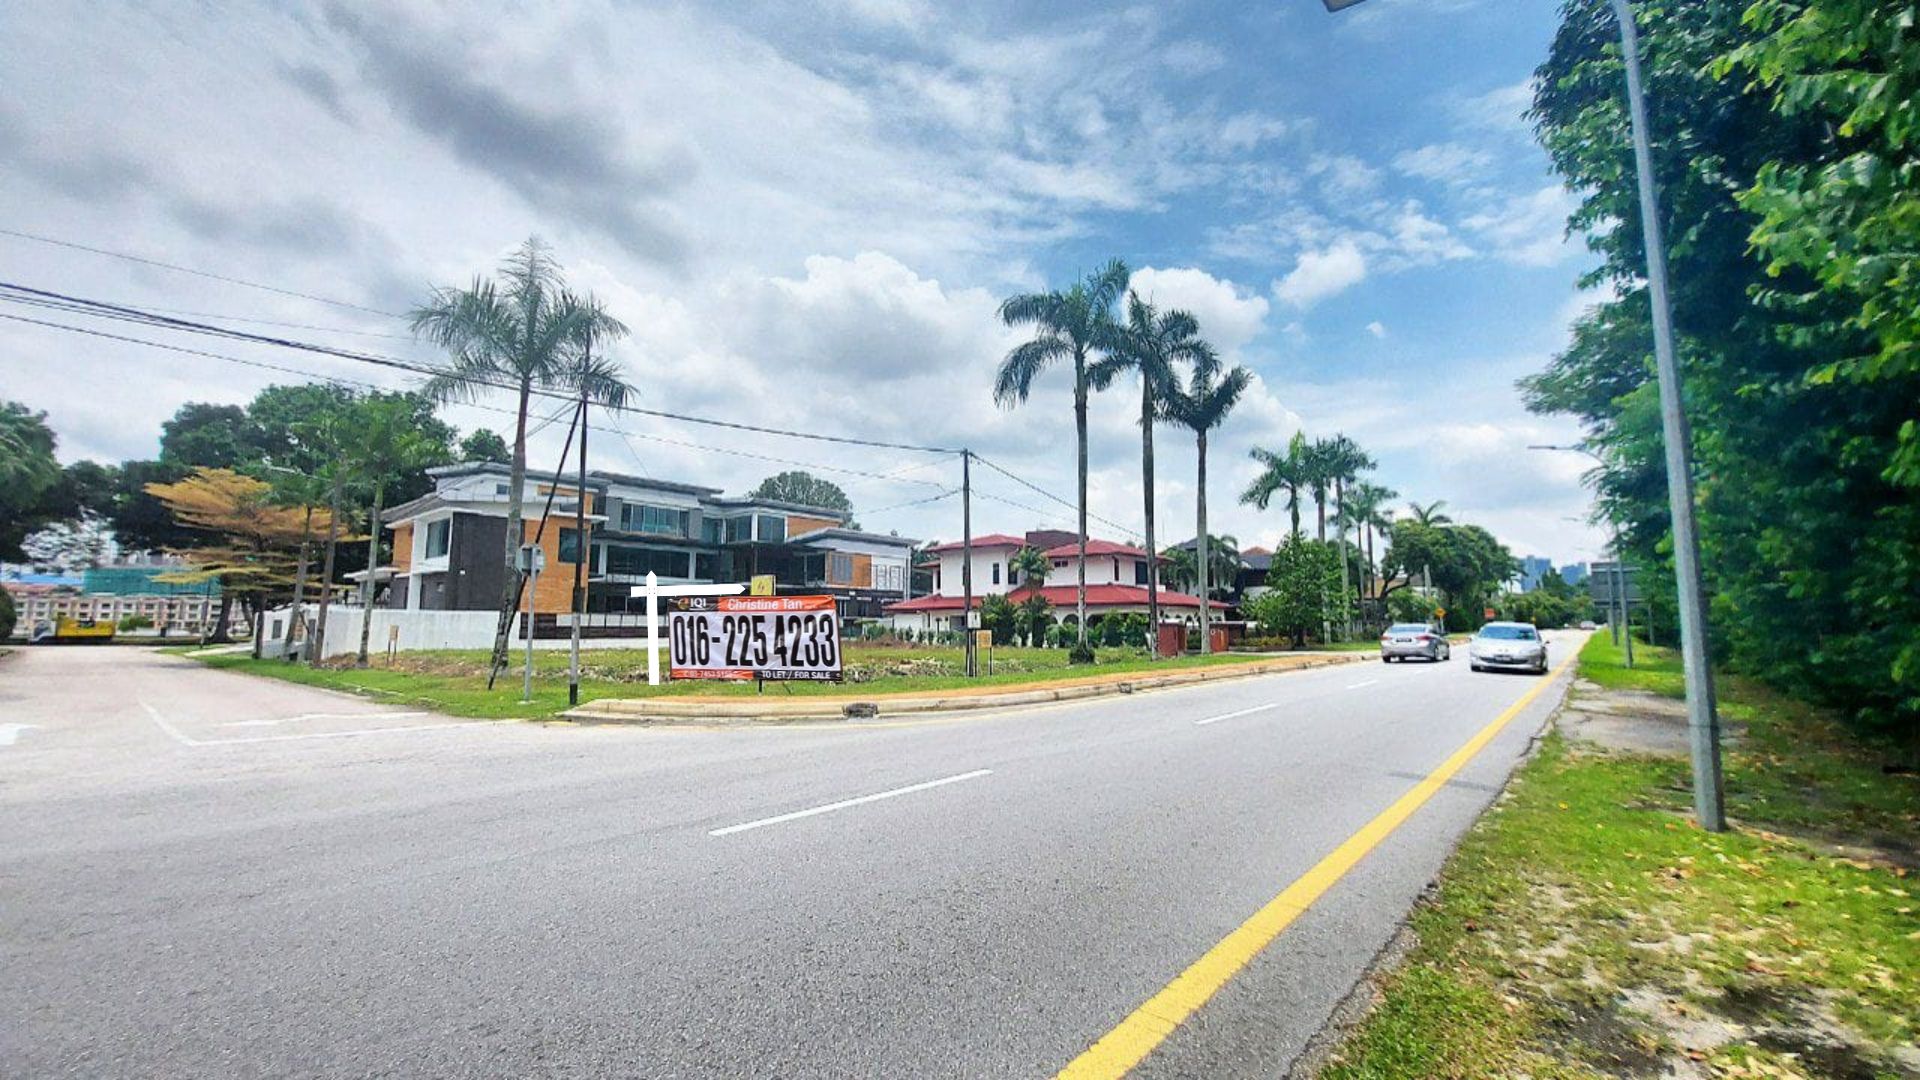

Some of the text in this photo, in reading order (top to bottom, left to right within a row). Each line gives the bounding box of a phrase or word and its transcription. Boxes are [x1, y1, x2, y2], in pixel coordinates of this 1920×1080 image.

[690, 598, 706, 608] IQI
[727, 598, 779, 610] Christine
[781, 598, 803, 610] Tan
[773, 613, 836, 667] 4233
[762, 671, 772, 679] TO
[794, 671, 809, 679] FOR
[811, 671, 831, 679] SALE
